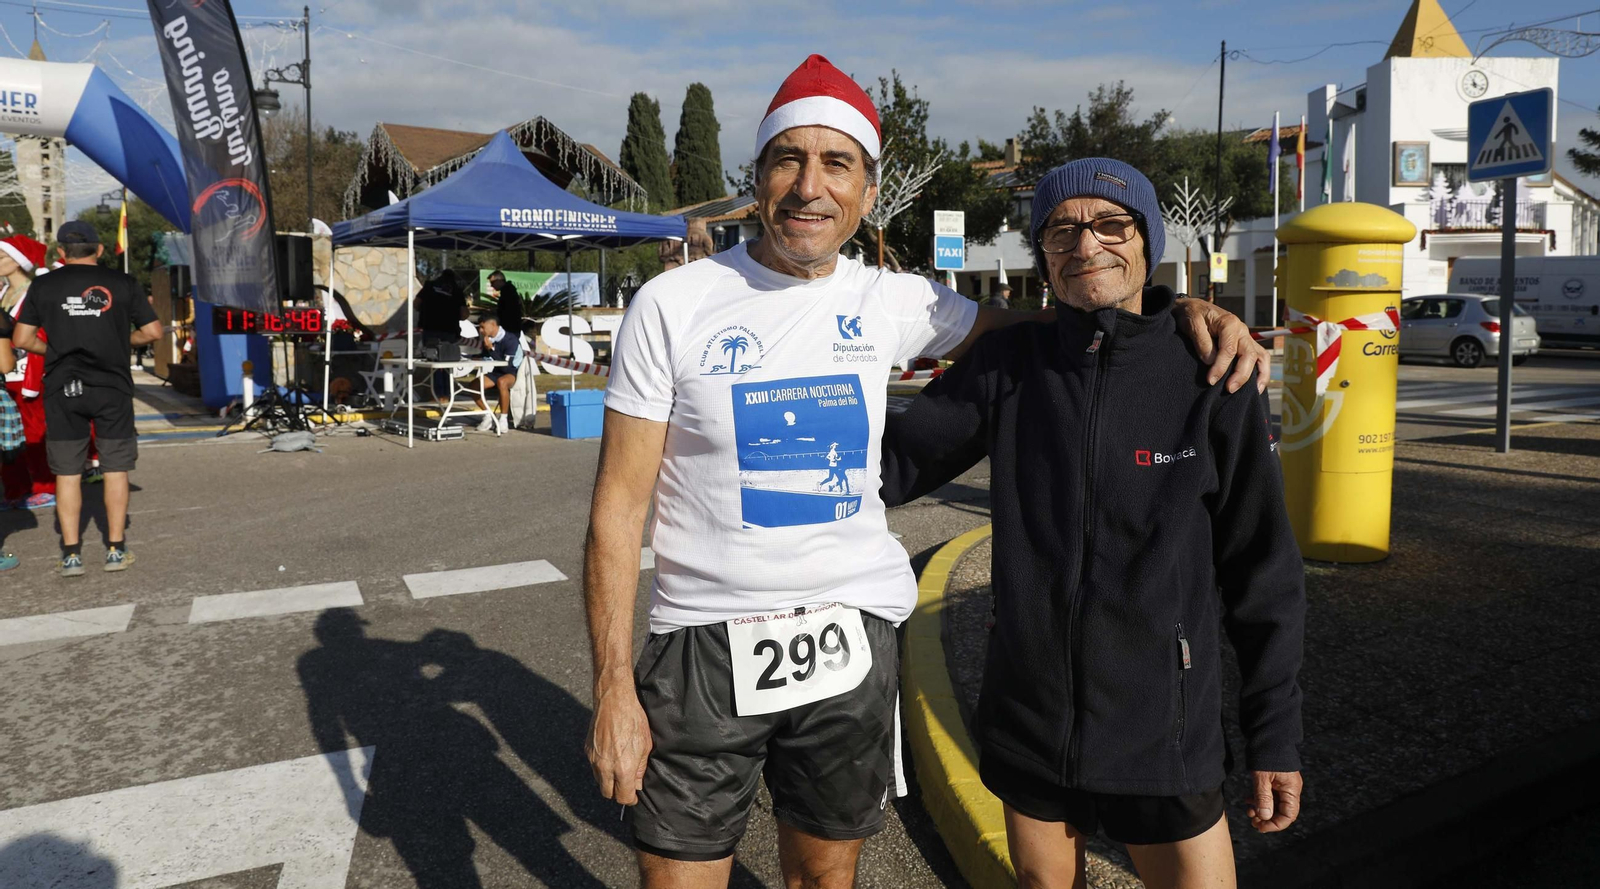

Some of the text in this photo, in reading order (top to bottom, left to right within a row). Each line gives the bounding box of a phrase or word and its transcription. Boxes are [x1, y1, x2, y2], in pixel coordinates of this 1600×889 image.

[1, 115, 42, 125] EVENTOS
[938, 247, 962, 258] TAXI
[700, 325, 764, 367] CLUB ATLETISMO PALMA DEL
[832, 342, 875, 353] Diputación
[833, 352, 878, 363] de Córdoba
[745, 383, 855, 406] XXIII CARRERA NOCTURNA
[818, 396, 859, 408] Palma del Río
[1358, 434, 1377, 444] 902
[835, 501, 848, 520] 01
[753, 622, 851, 691] 299
